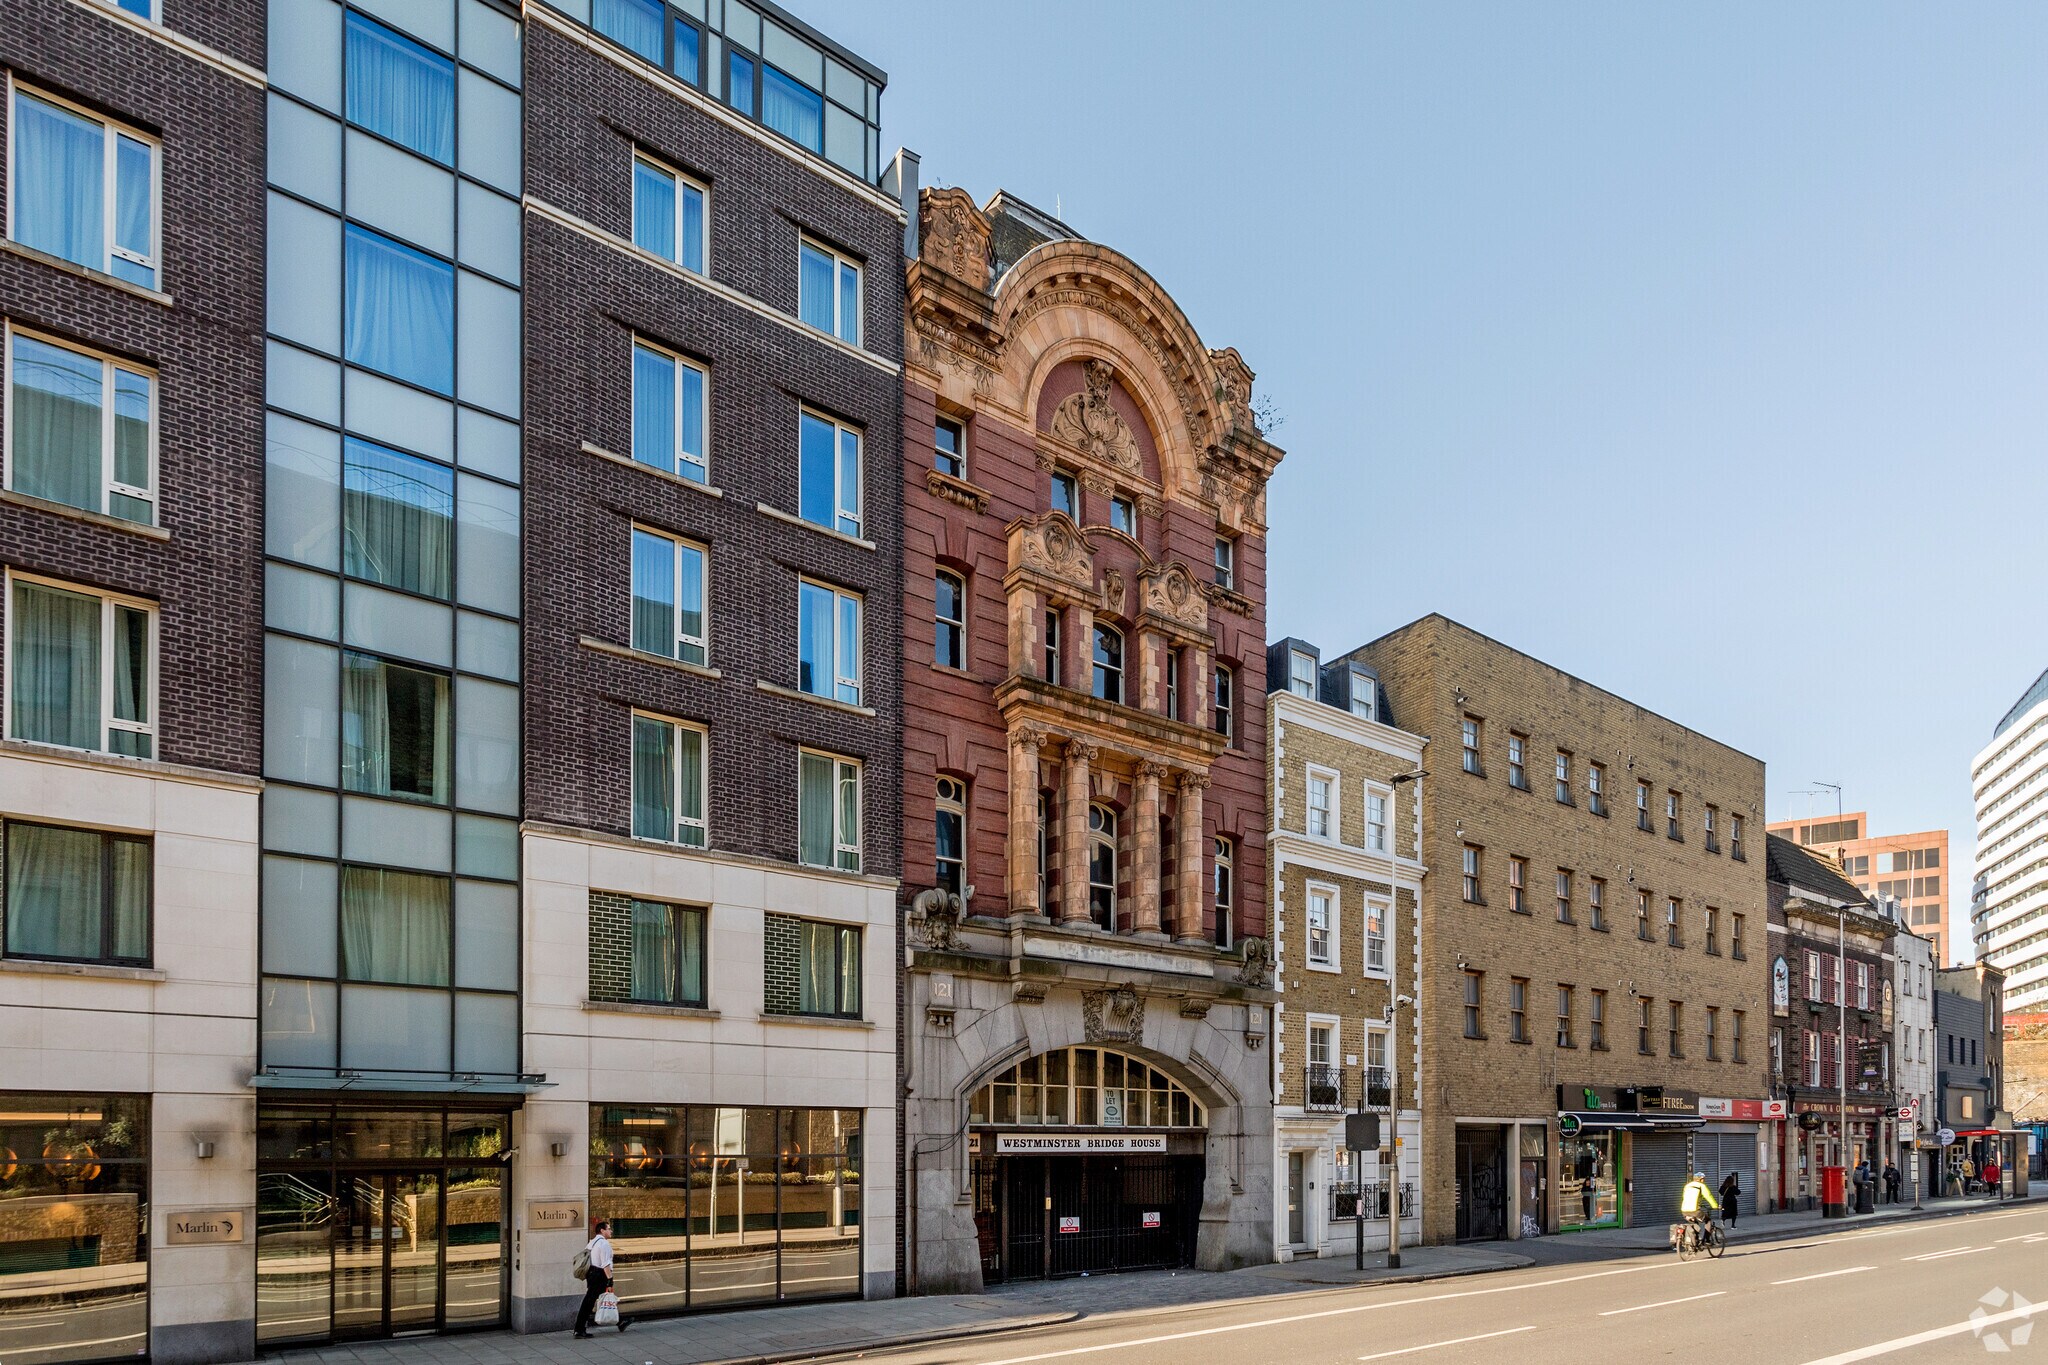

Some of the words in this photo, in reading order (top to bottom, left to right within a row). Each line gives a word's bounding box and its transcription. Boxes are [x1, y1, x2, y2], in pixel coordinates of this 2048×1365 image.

[934, 983, 952, 998] 121
[1250, 1012, 1262, 1024] 121
[1663, 1097, 1684, 1109] FTREE
[1811, 1104, 1828, 1112] CROWN
[969, 1138, 978, 1147] 21
[1003, 1138, 1080, 1148] WESTMINSTER
[1088, 1138, 1124, 1147] BRIDGE
[1131, 1138, 1160, 1147] HOUSE
[537, 1210, 567, 1220] Marlin
[176, 1222, 218, 1234] Marlin
